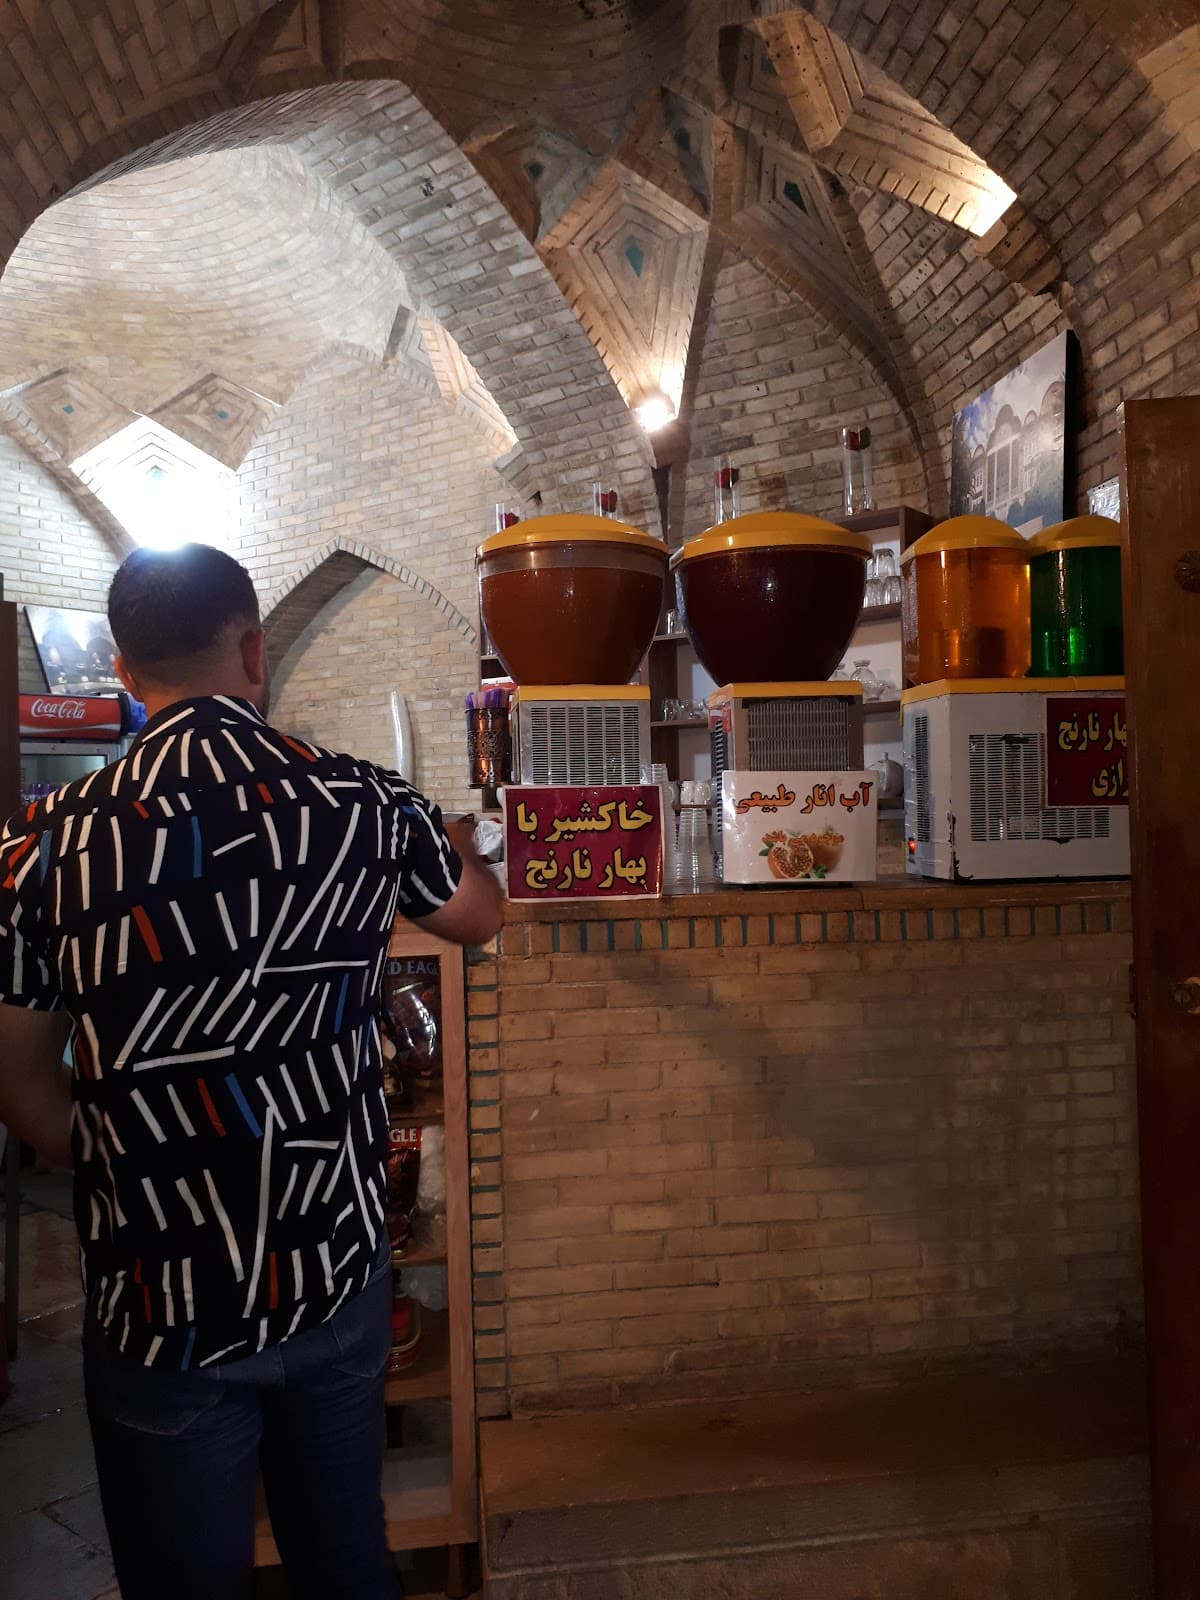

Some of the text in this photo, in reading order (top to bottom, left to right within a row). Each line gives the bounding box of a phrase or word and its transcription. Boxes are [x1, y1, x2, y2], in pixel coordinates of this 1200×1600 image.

[1058, 711, 1127, 751] هار نارنج
[734, 781, 874, 814] آب انار طبیعی
[516, 800, 654, 842] خاکشیر با
[525, 847, 647, 889] بهار نارنج
